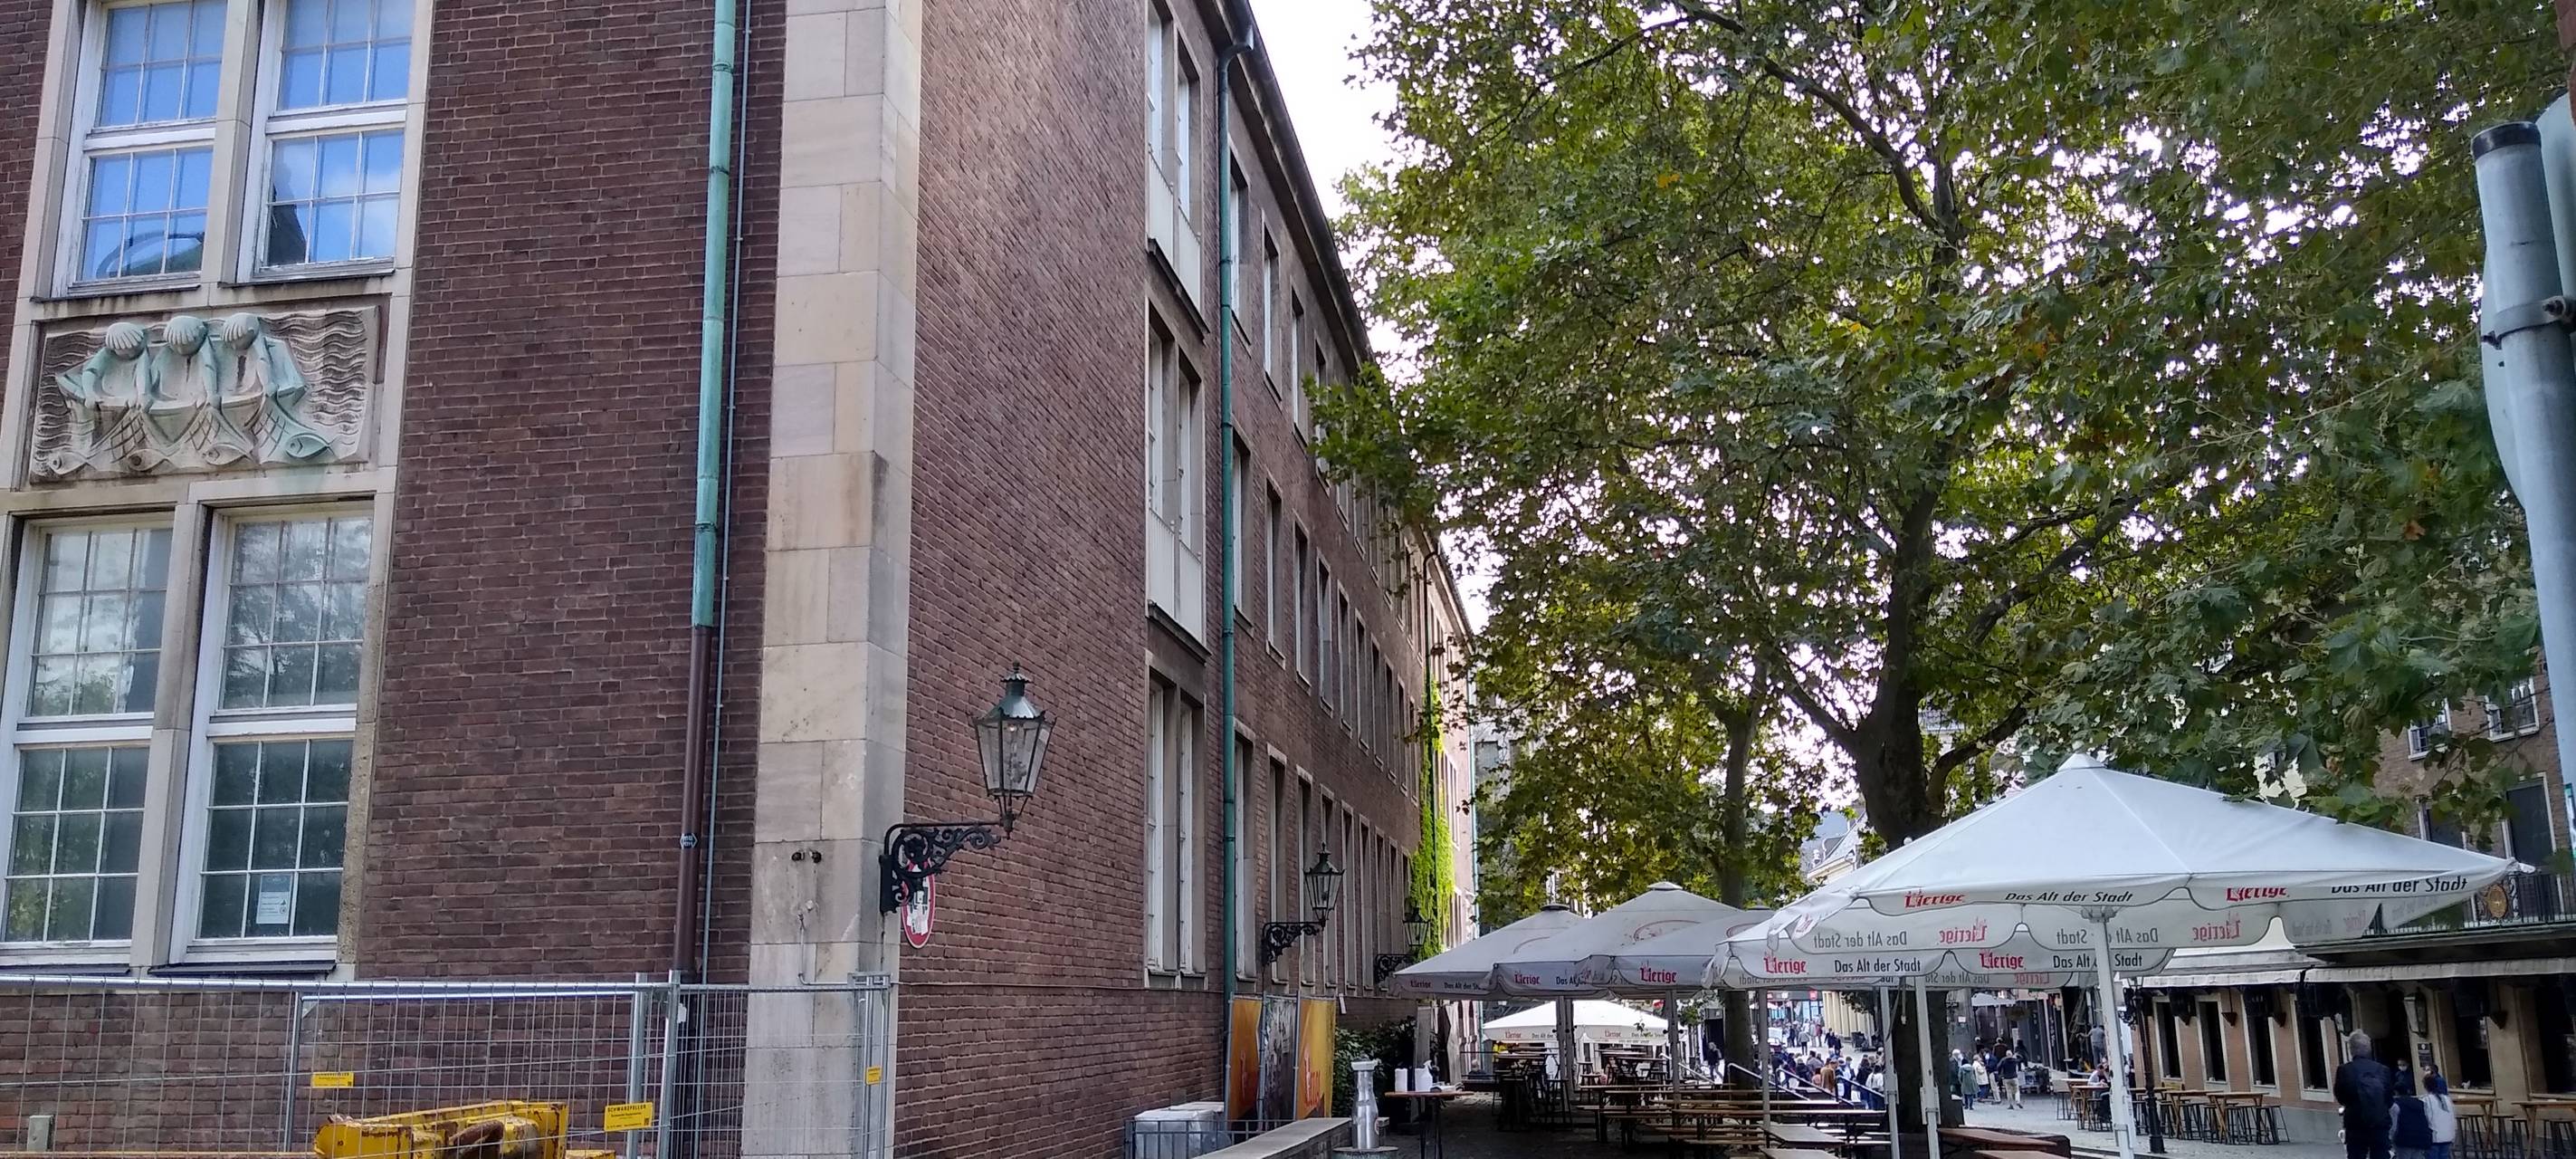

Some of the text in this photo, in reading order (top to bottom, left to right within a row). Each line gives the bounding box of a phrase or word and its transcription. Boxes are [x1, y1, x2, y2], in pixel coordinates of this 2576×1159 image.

[2425, 876, 2468, 893] Stadt
[2004, 891, 2133, 903] Das Alt der Stadt
[1763, 955, 1807, 974] Uerige
[1834, 957, 1921, 973] Das Alt der Stadt
[1979, 951, 2024, 970] Uerige
[2053, 955, 2073, 968] Das
[2076, 953, 2090, 968] Alt
[2114, 953, 2142, 966] Stadt
